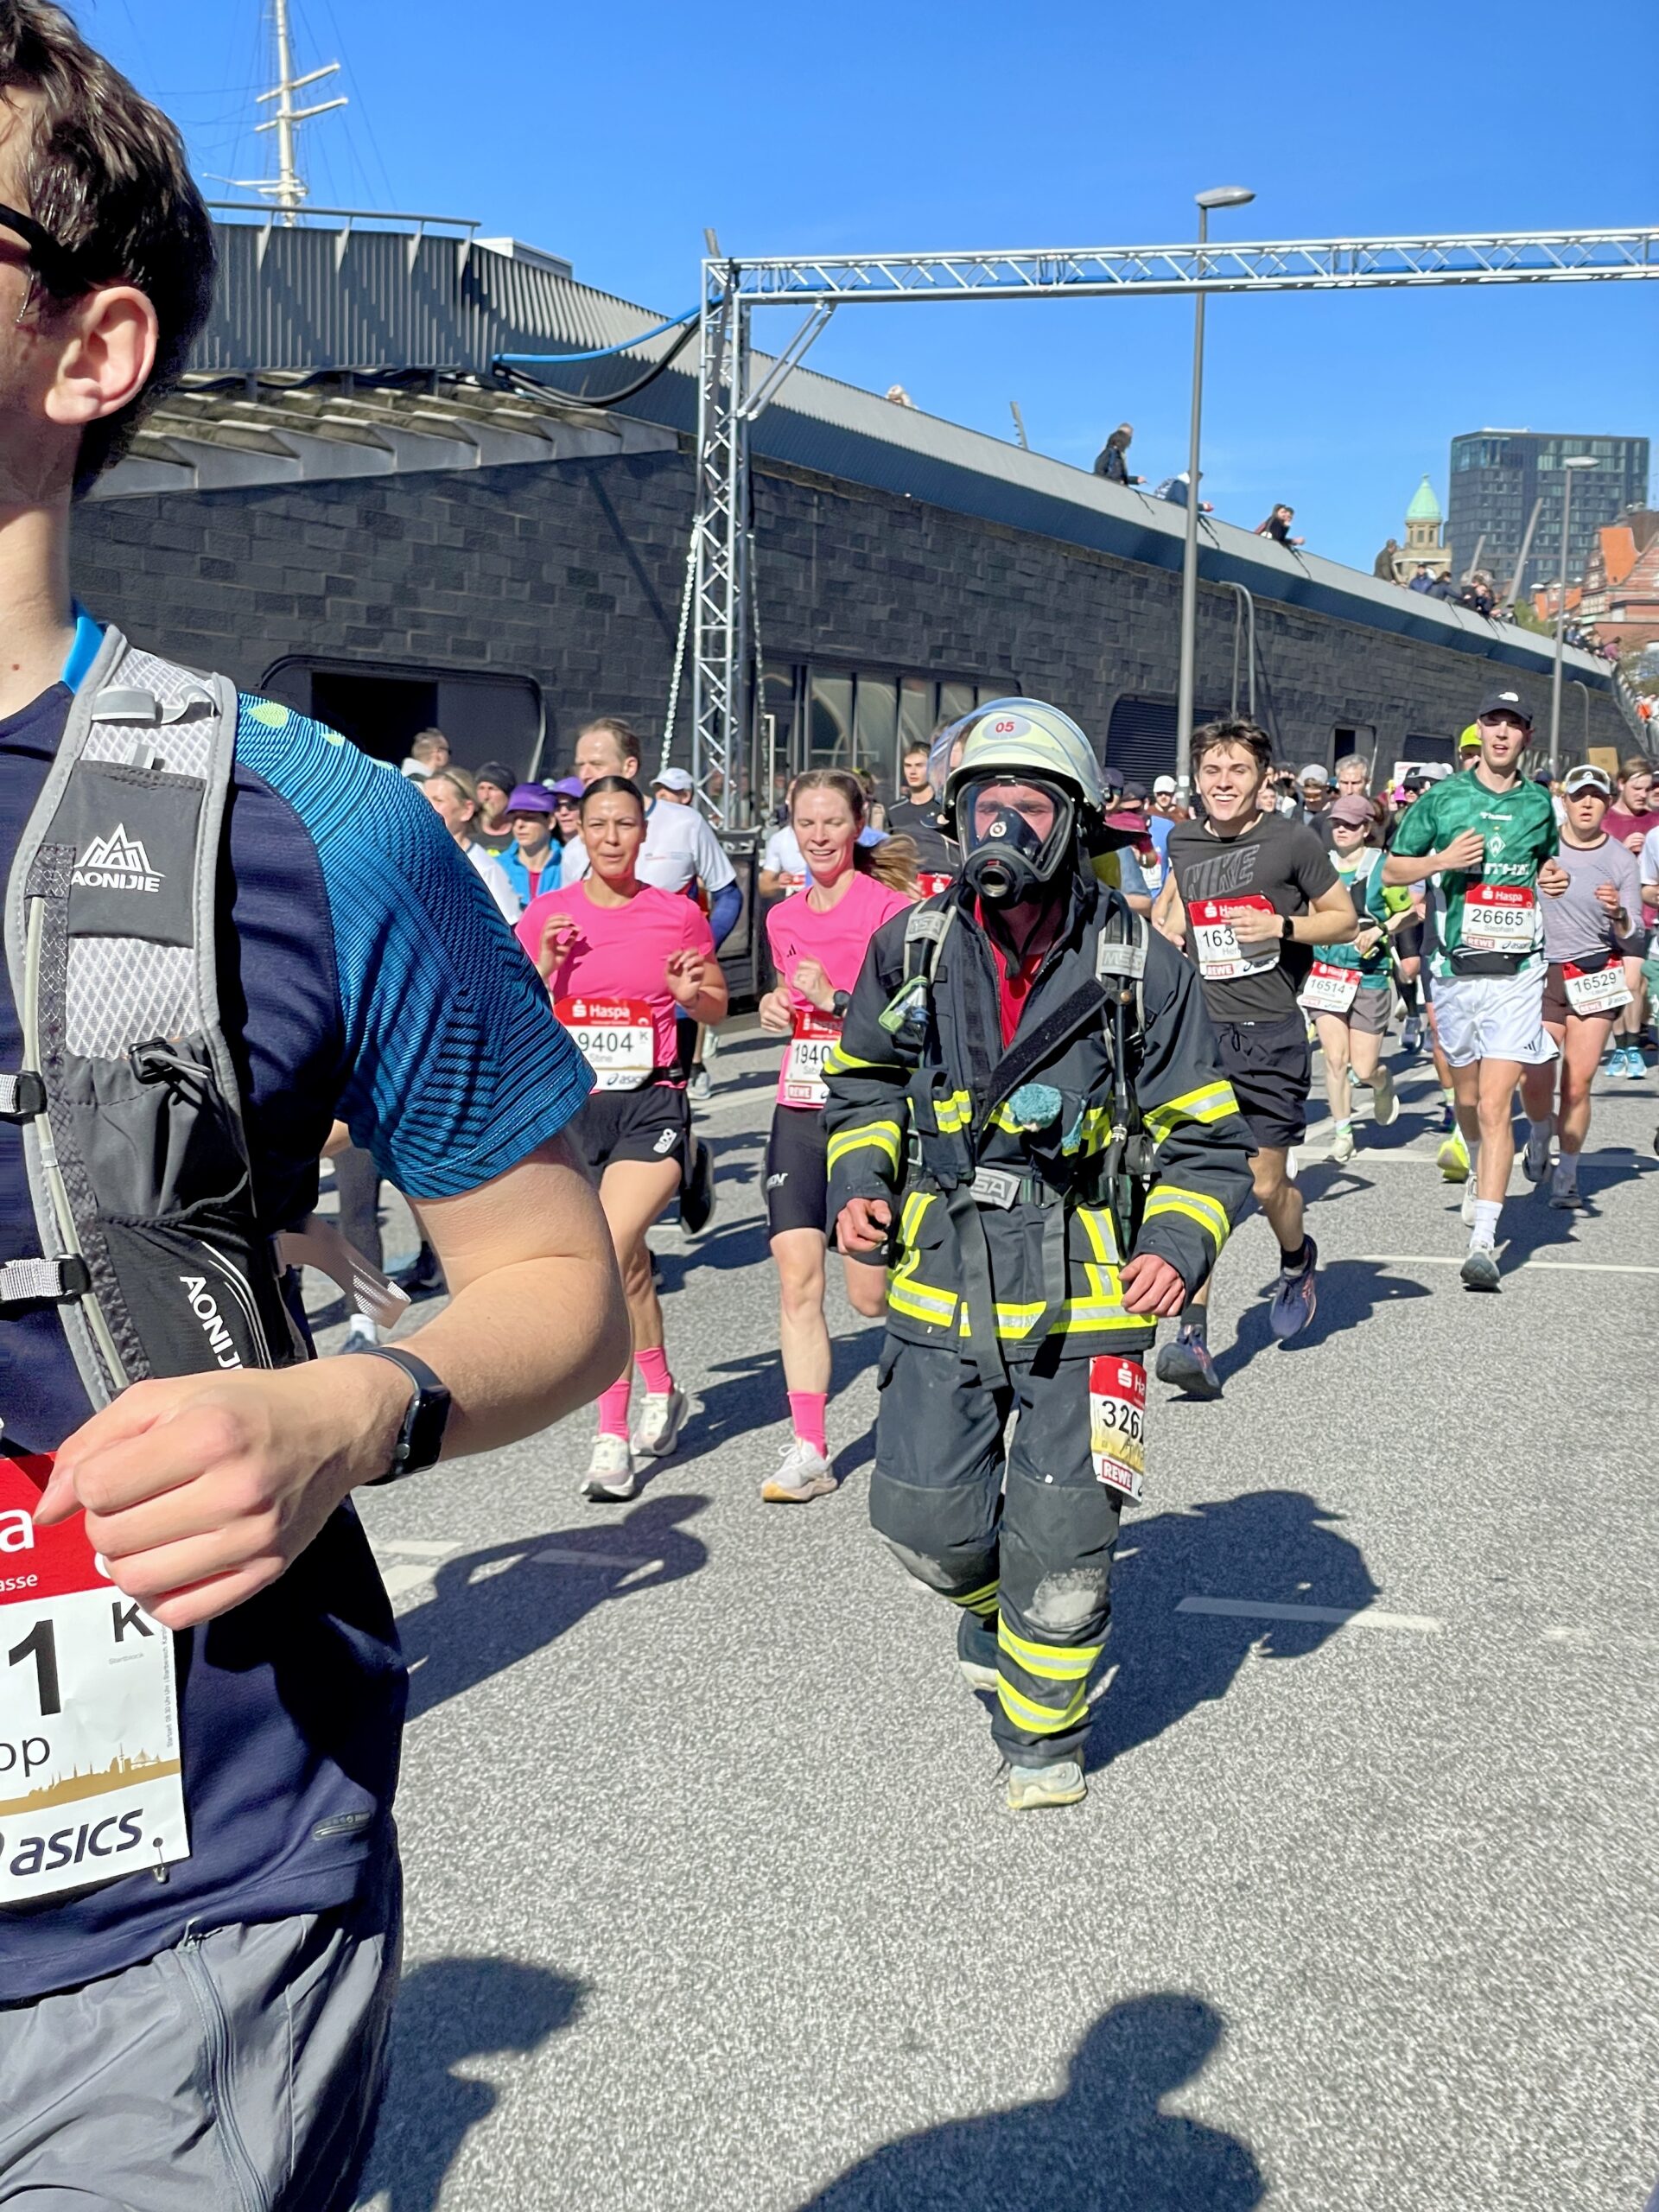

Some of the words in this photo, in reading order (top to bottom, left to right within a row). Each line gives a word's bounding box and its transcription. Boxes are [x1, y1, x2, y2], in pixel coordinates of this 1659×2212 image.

[995, 721, 1015, 733] 05
[71, 870, 161, 893] AONIJIE
[1182, 844, 1261, 900] NIKE
[1495, 891, 1523, 903] Haspa
[1471, 908, 1524, 925] 26665
[1202, 929, 1236, 948] 163
[1468, 937, 1495, 948] REWE
[1207, 965, 1233, 976] REWE
[1311, 978, 1345, 994] 16514
[1574, 972, 1617, 993] 16529
[589, 1004, 631, 1020] Haspa
[571, 1032, 635, 1052] 9404
[639, 1031, 649, 1042] K
[589, 1052, 613, 1064] Stine
[179, 1276, 244, 1370] AONIJ
[1102, 1401, 1144, 1445] 326
[1103, 1460, 1133, 1490] REWE
[0, 1509, 35, 1553] a
[9, 1618, 61, 1717] 1
[111, 1601, 155, 1643] K
[10, 1808, 144, 1876] asics
